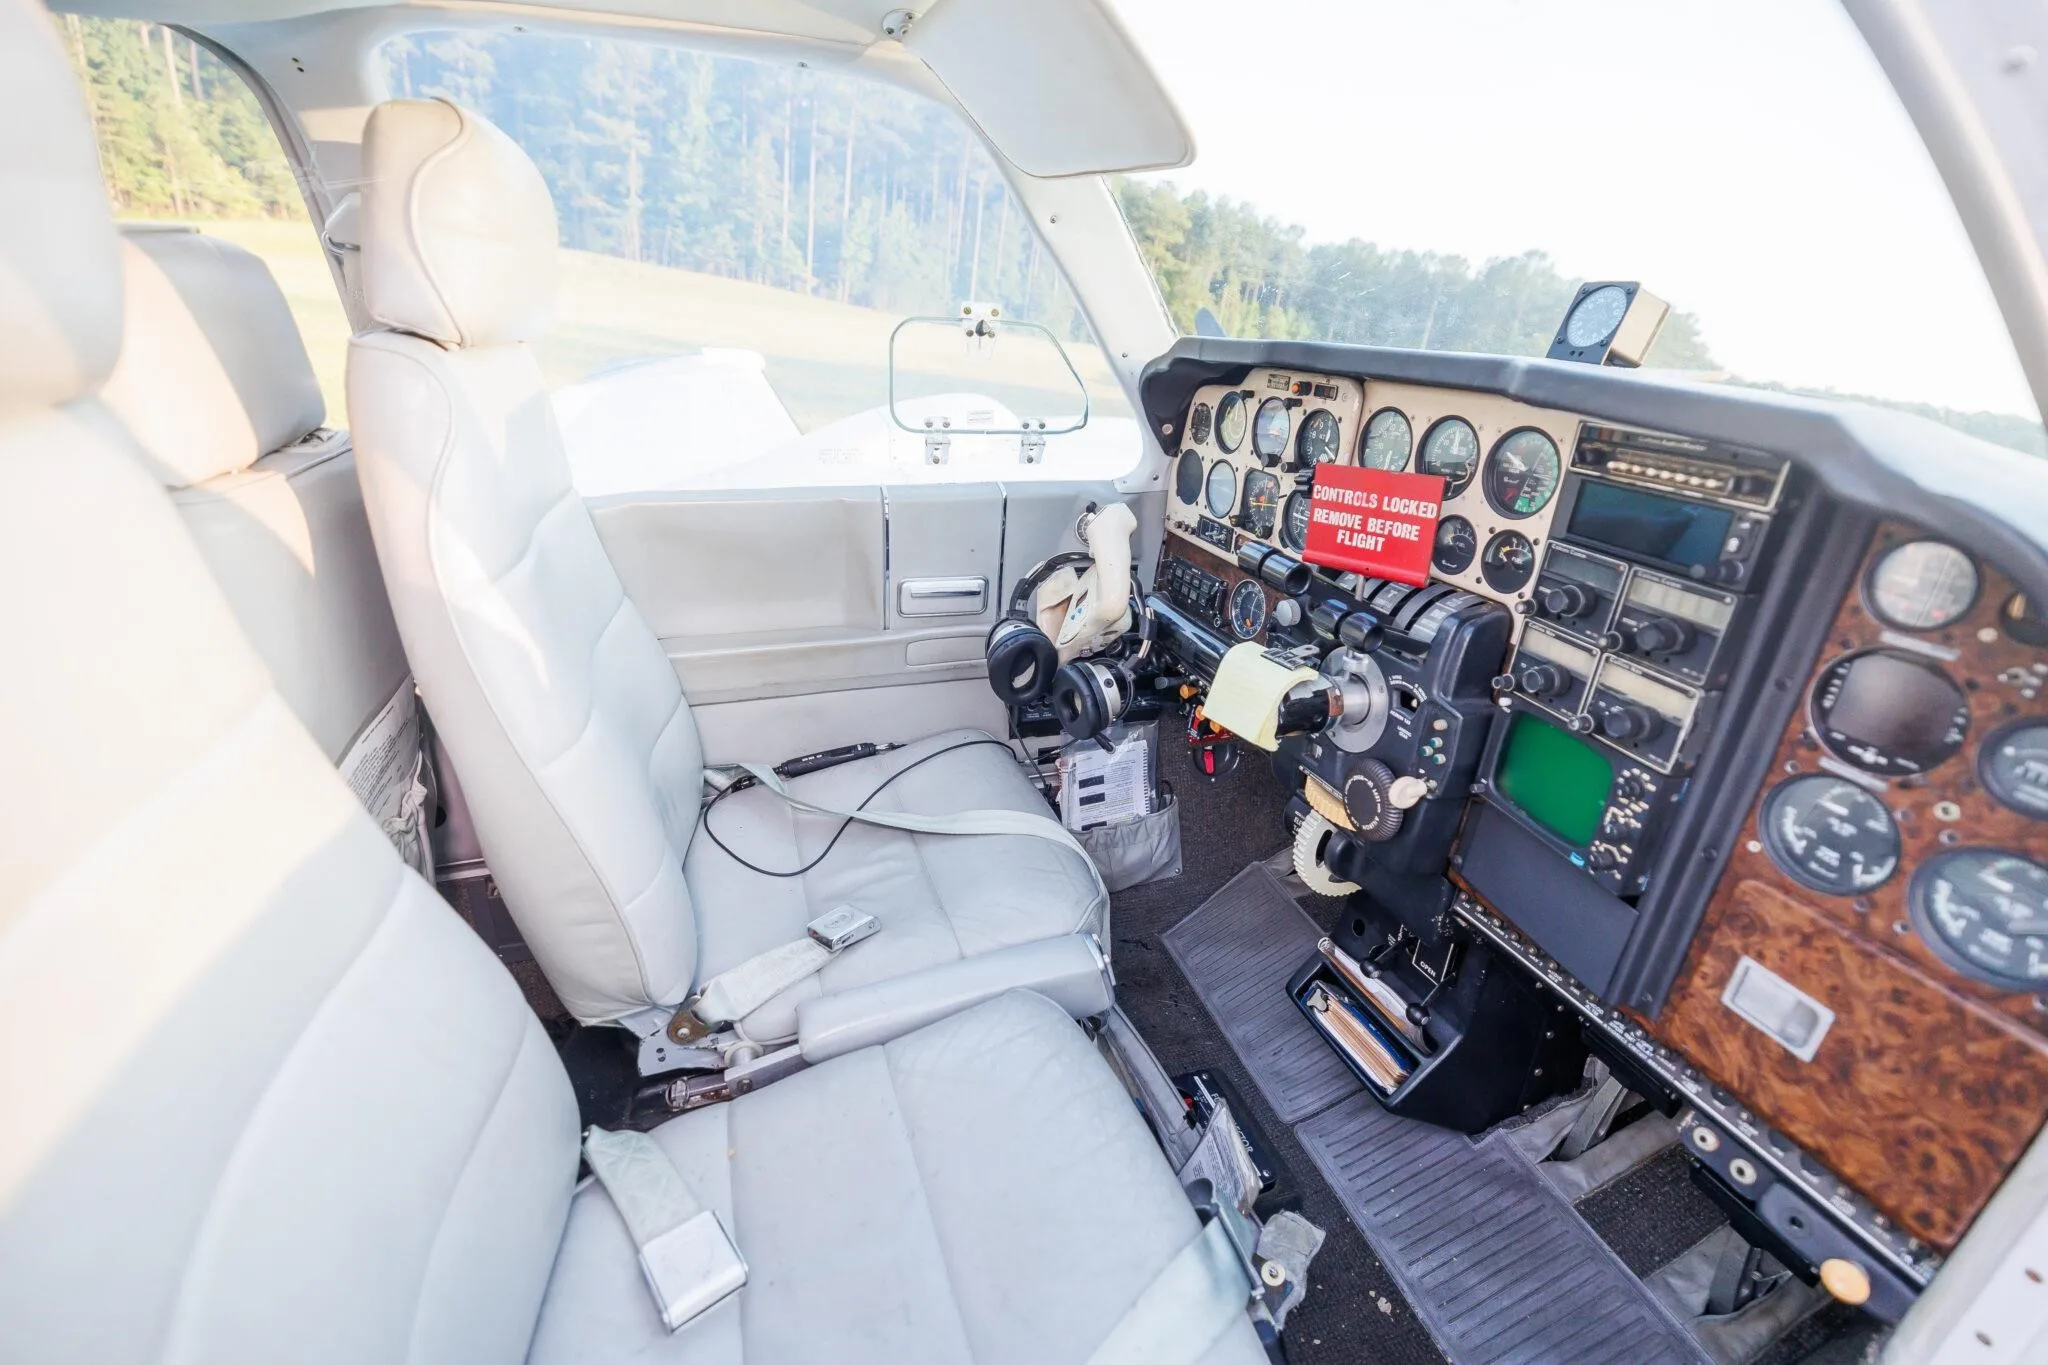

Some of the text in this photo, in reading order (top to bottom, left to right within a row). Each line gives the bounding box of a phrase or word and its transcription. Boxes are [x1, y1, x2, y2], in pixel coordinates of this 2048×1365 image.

[1313, 484, 1438, 519] CONTROLS LOCKED
[1313, 508, 1420, 540] REMOVE BEFORE
[1336, 530, 1385, 552] FLIGHT
[1420, 961, 1436, 977] OPEN
